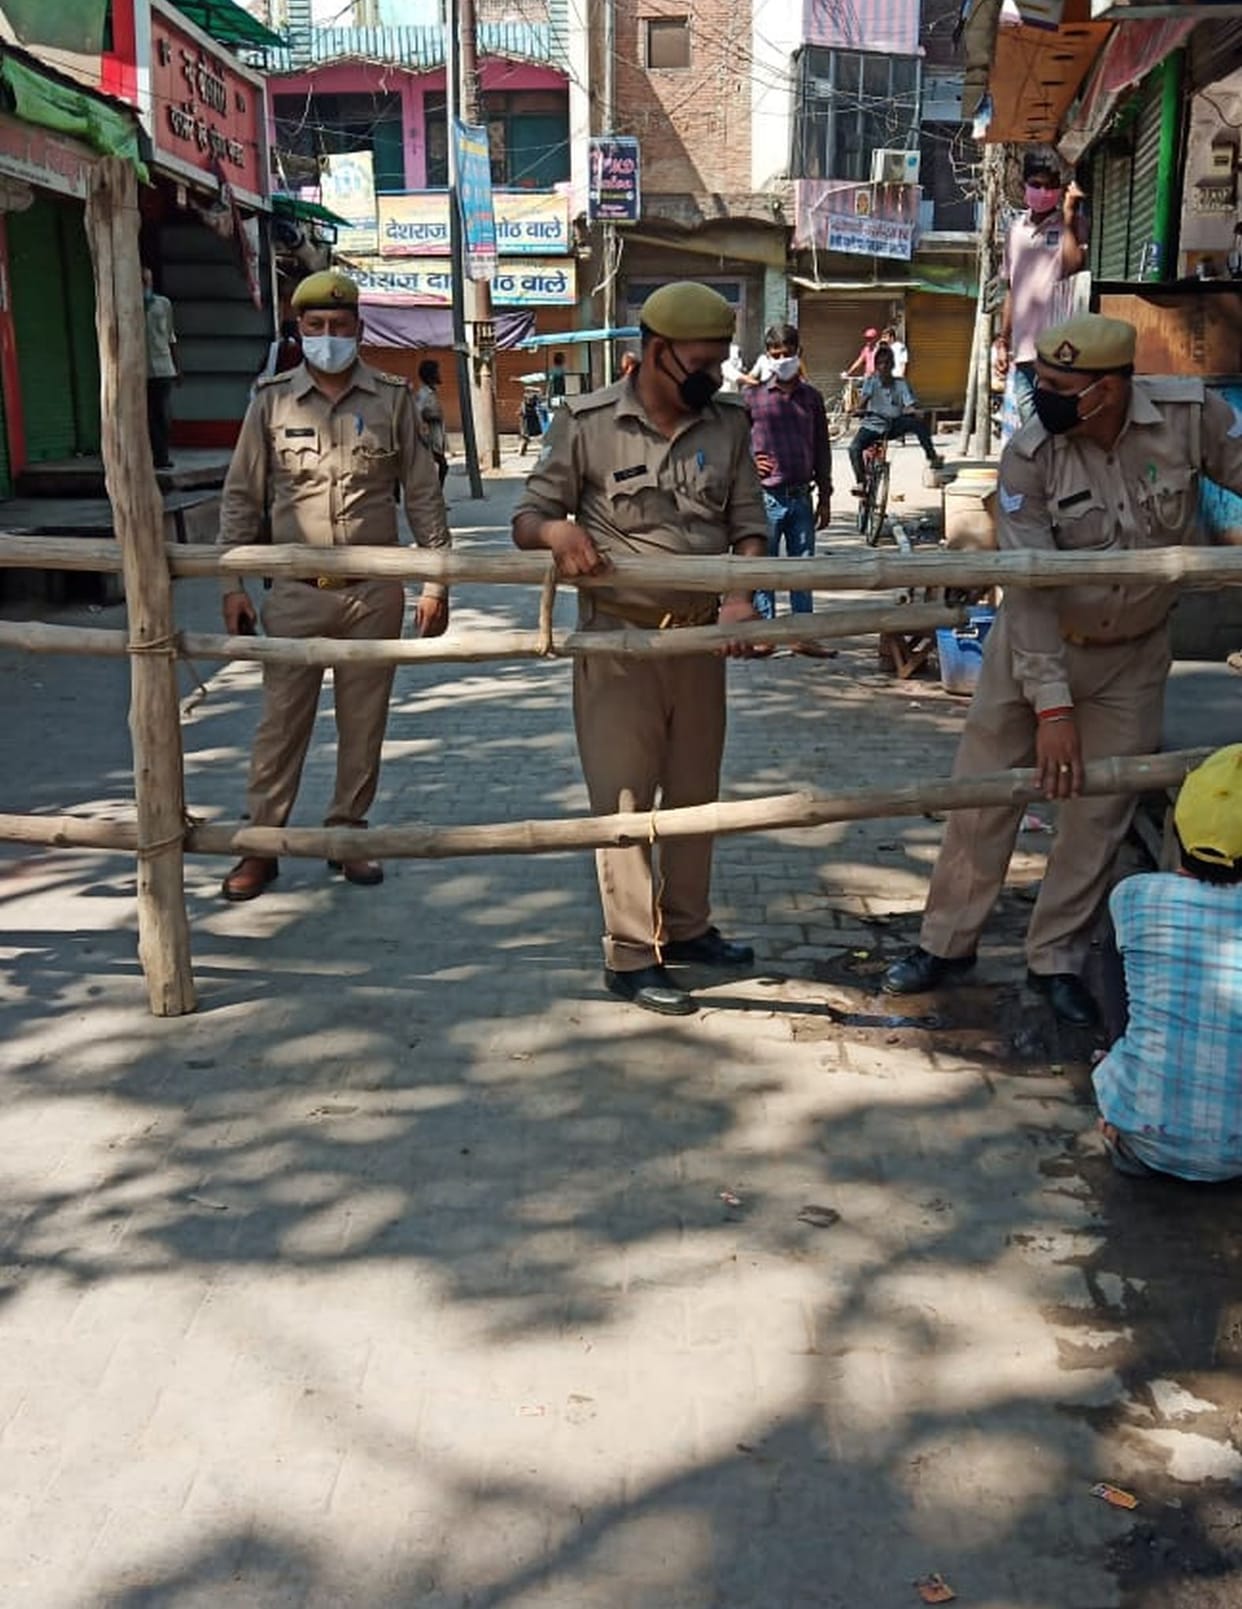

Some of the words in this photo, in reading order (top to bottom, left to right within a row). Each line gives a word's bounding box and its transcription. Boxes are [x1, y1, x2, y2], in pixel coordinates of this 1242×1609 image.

[385, 217, 448, 239] देशराज
[525, 216, 563, 238] वाले
[426, 272, 450, 289] दा
[521, 270, 568, 293] वाले
